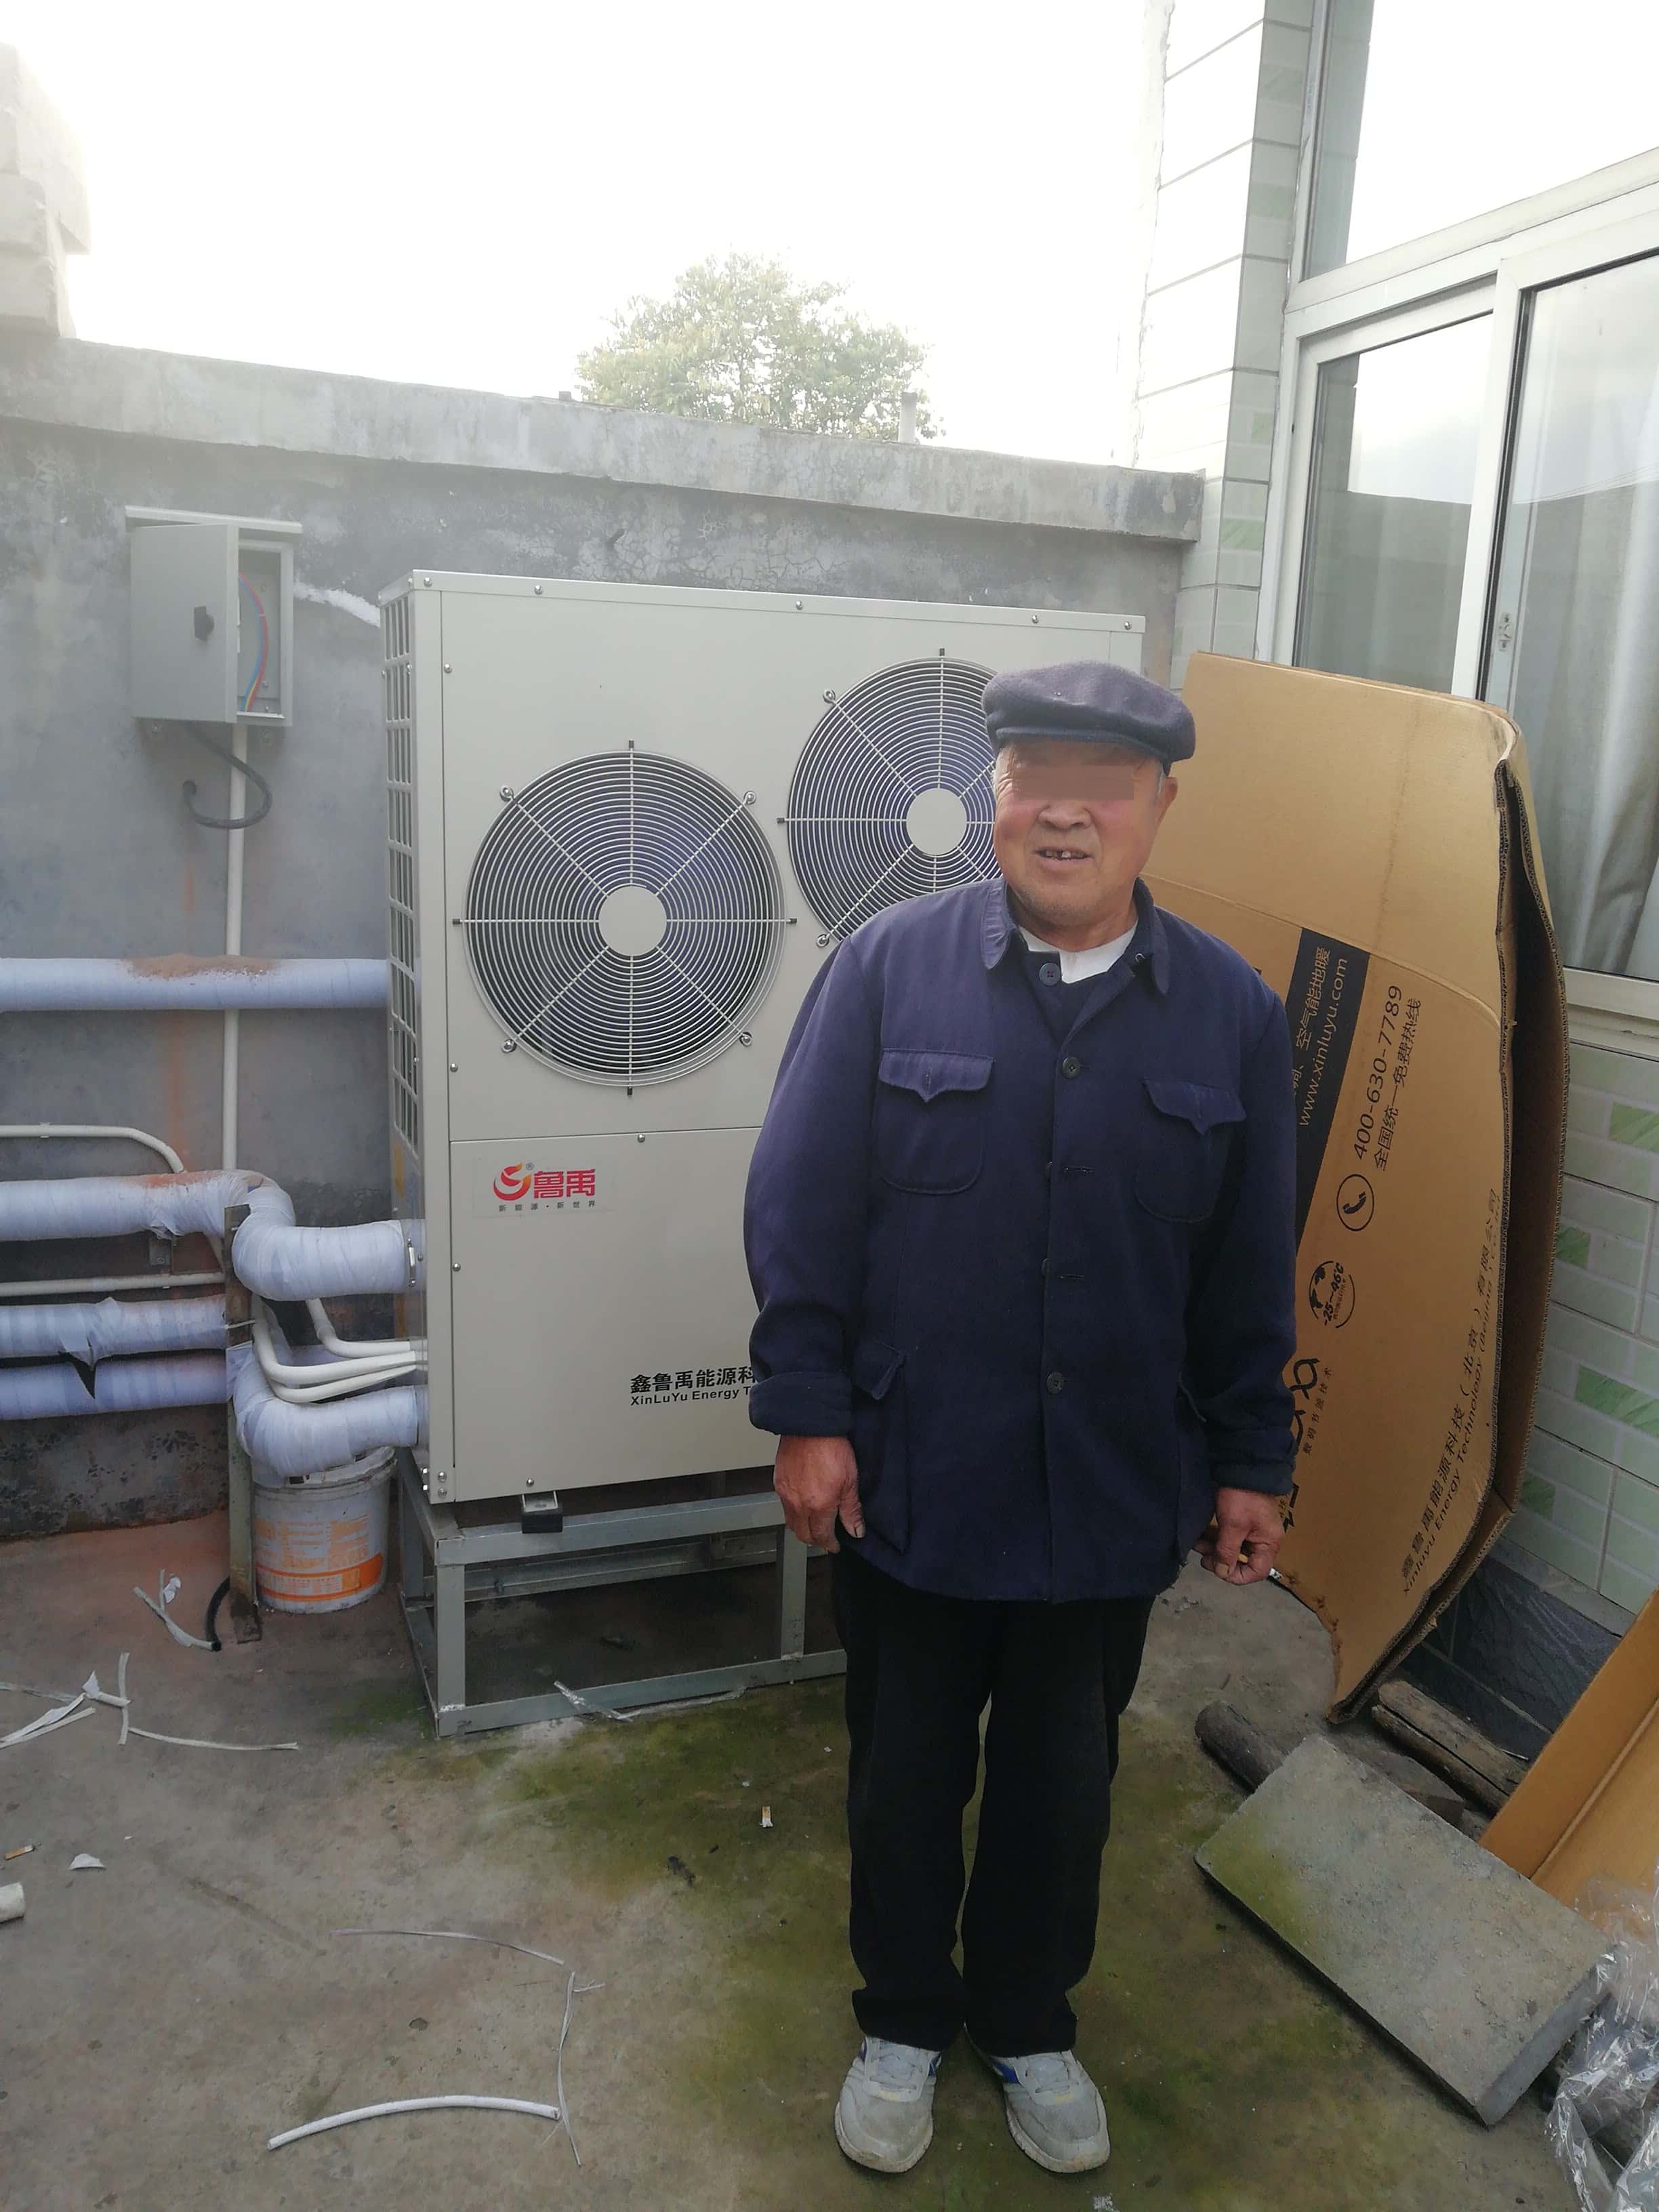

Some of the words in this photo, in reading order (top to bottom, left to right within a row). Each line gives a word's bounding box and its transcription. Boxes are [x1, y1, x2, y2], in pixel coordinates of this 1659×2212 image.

[1299, 958, 1348, 1126] www.xinluyu.com
[1353, 985, 1402, 1160] 400-630-7789
[1374, 997, 1421, 1172] 全国统一免费热线
[533, 1169, 596, 1199] 鲁禹
[630, 1366, 756, 1394] 鑫鲁禹能源科
[630, 1392, 688, 1406] XinLuYu
[692, 1389, 739, 1399] Energy
[743, 1386, 752, 1395] T
[1435, 1469, 1460, 1531] Energy
